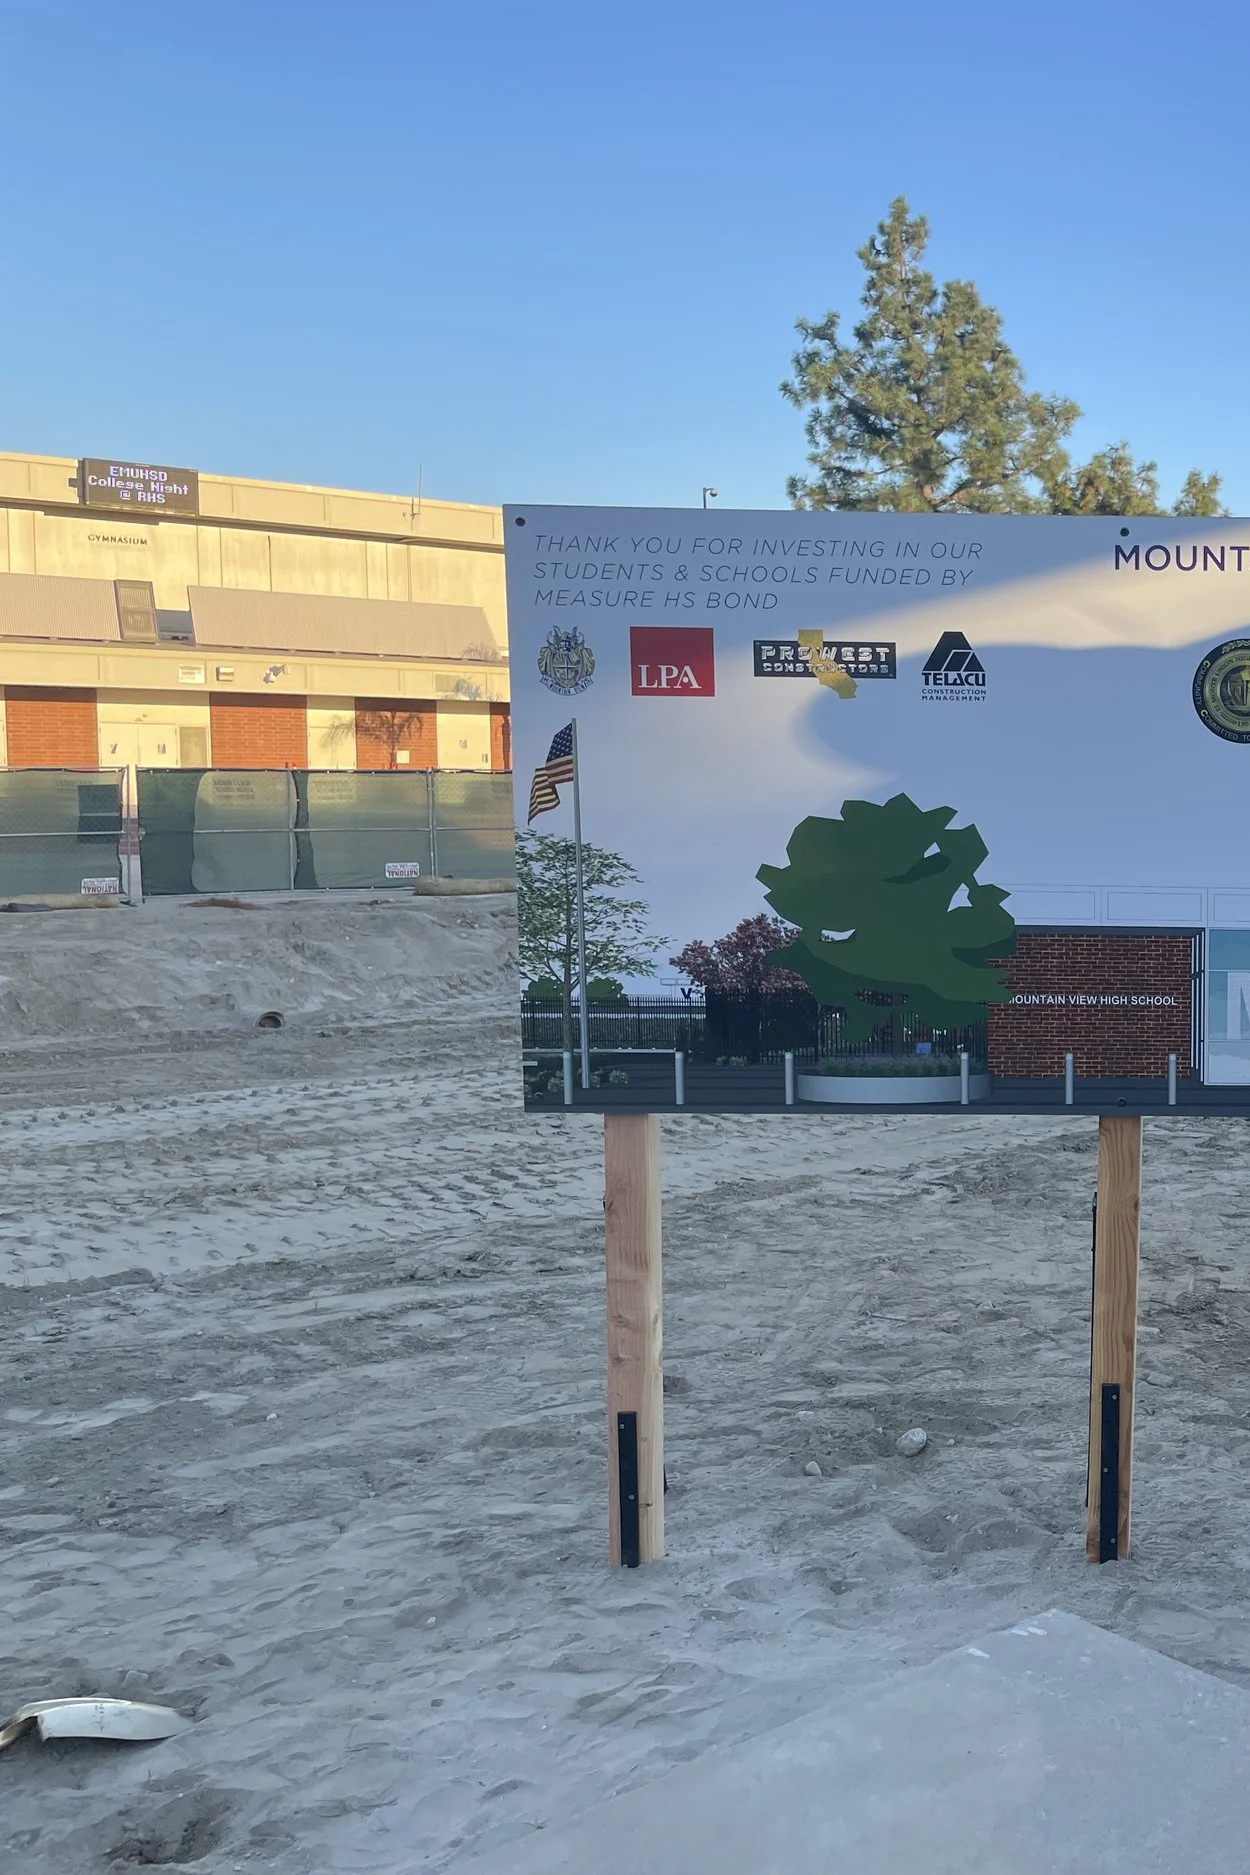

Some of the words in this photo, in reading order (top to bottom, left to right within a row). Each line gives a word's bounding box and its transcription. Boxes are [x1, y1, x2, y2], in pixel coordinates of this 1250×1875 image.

[109, 465, 168, 482] EMUHSD
[88, 475, 144, 490] College
[150, 481, 189, 495] Night
[120, 490, 131, 500] @
[137, 491, 166, 504] RHS
[87, 533, 148, 545] GYMNASIUM
[534, 535, 620, 552] THANK
[631, 536, 682, 554] YOU
[692, 537, 743, 555] FOR
[753, 539, 885, 558] INVESTING
[895, 541, 920, 558] IN
[930, 542, 983, 559] OUR
[533, 562, 665, 581] STUDENTS
[674, 564, 688, 581] &
[699, 564, 818, 584] SCHOOLS
[828, 567, 931, 585] FUNDED
[941, 569, 974, 586] BY
[534, 589, 655, 608] MEASURE
[664, 591, 696, 609] HS
[706, 592, 778, 610] BOND
[638, 664, 702, 688] LPA
[762, 662, 889, 674] CONSTRUCTORS
[921, 672, 986, 687] TELACU
[82, 885, 118, 895] NATIONAL
[1069, 995, 1099, 1005] VIEW
[1100, 996, 1128, 1005] HIGH
[1130, 996, 1178, 1006] SCHOOL
